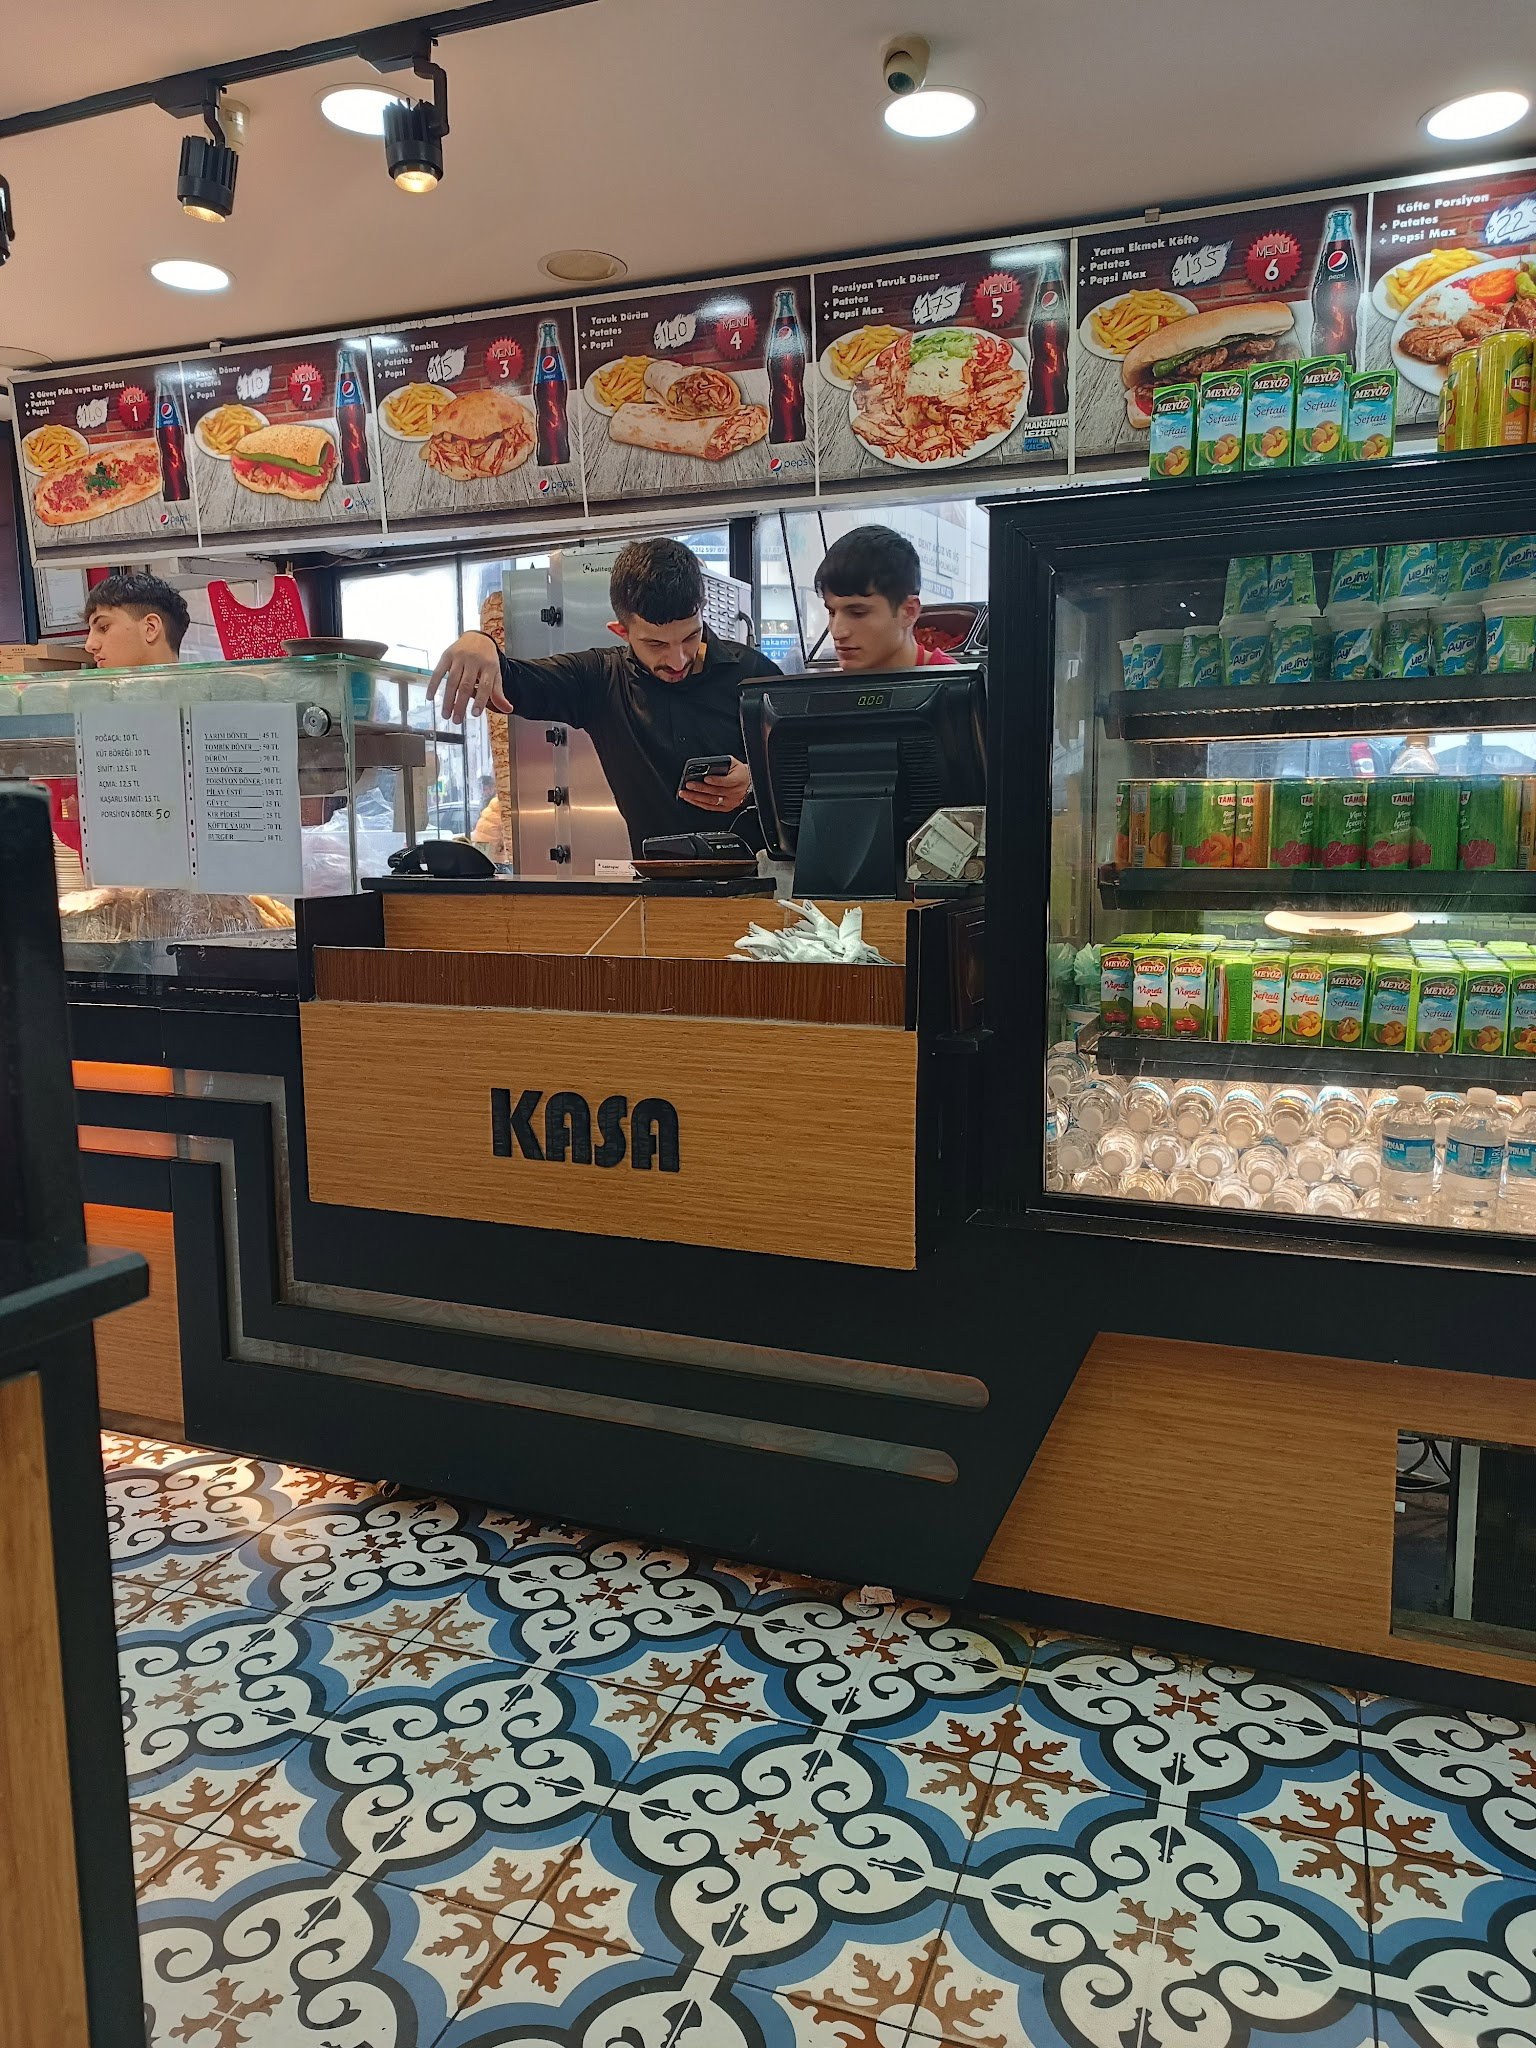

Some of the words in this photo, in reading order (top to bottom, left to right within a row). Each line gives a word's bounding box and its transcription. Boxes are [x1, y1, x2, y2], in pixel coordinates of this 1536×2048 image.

[1397, 201, 1430, 214] Köfte
[1434, 194, 1490, 209] Porsiyon
[1392, 215, 1439, 229] Patates
[1392, 230, 1424, 244] Pepsi
[1429, 228, 1457, 239] Max
[1093, 246, 1125, 258] Yarım
[1129, 240, 1165, 252] Ekmek
[1169, 234, 1200, 246] Köfte
[1256, 241, 1290, 258] MENÜ
[1090, 259, 1131, 272] Patates
[1265, 259, 1279, 281] 6
[832, 281, 874, 295] Porsiyon
[877, 275, 907, 288] Tavuk
[910, 272, 940, 284] Döner
[1090, 273, 1118, 286] Pepsi
[1122, 269, 1147, 281] Max
[983, 283, 1014, 296] MENÜ
[832, 295, 869, 307] Patates
[833, 308, 859, 320] Pepsi
[862, 306, 885, 315] Max
[991, 297, 1005, 319] 5
[591, 315, 618, 325] Tavuk
[620, 311, 649, 322] Dürüm
[721, 317, 750, 330] MENÜ
[589, 327, 622, 338] Patates
[411, 341, 439, 352] Tombik
[590, 340, 614, 350] Pepsi
[729, 331, 743, 350] 4
[491, 348, 516, 359] MENÜ
[384, 357, 413, 367] Patates
[219, 366, 240, 375] Döner
[385, 370, 406, 379] Pepsi
[499, 360, 510, 379] 3
[1253, 377, 1289, 390] MEYÖZ
[1303, 371, 1340, 384] MEYÖZ
[36, 388, 57, 399] Güveç
[58, 388, 73, 396] Pide
[74, 386, 91, 395] veya
[104, 381, 125, 391] Pidesi
[196, 380, 222, 389] Patates
[196, 390, 216, 400] Pepsi
[302, 384, 313, 402] 2
[1205, 386, 1240, 398] MEYÖZ
[1354, 386, 1390, 400] MEYÖZ
[31, 399, 55, 408] Patates
[1157, 399, 1190, 412] MEYÖZ
[1303, 399, 1337, 412] Şeftali
[32, 408, 50, 417] Pepsi
[131, 405, 139, 422] 1
[1253, 404, 1287, 418] Şeftali
[1024, 418, 1069, 430] MAKSİMUM
[1206, 412, 1238, 426] Şeftali
[1354, 413, 1388, 427] Şeftali
[1340, 570, 1371, 589] Ayran
[1233, 649, 1263, 666] Ayran
[1279, 656, 1309, 674] Ayran
[123, 734, 131, 742] 10
[155, 808, 171, 819] 50
[1104, 960, 1131, 969] MEYÖZ
[1137, 963, 1164, 973] MEYÖZ
[1174, 965, 1203, 974] MEYÖZ
[1253, 968, 1281, 979] MEYÖZ
[1292, 970, 1320, 980] MEYÖZ
[1331, 976, 1362, 987] MEYÖZ
[1378, 979, 1411, 991] MEYÖZ
[1423, 985, 1457, 996] MEYÖZ
[1471, 983, 1504, 994] MEYÖZ
[1253, 989, 1280, 1001] Şeftali
[1290, 991, 1320, 1003] Şeftali
[1331, 998, 1360, 1009] Şeftali
[1377, 1001, 1407, 1012] Şeftali
[1423, 1008, 1453, 1019] Şeftali
[1471, 1006, 1502, 1017] Şeftali
[490, 1087, 680, 1173] KASA
